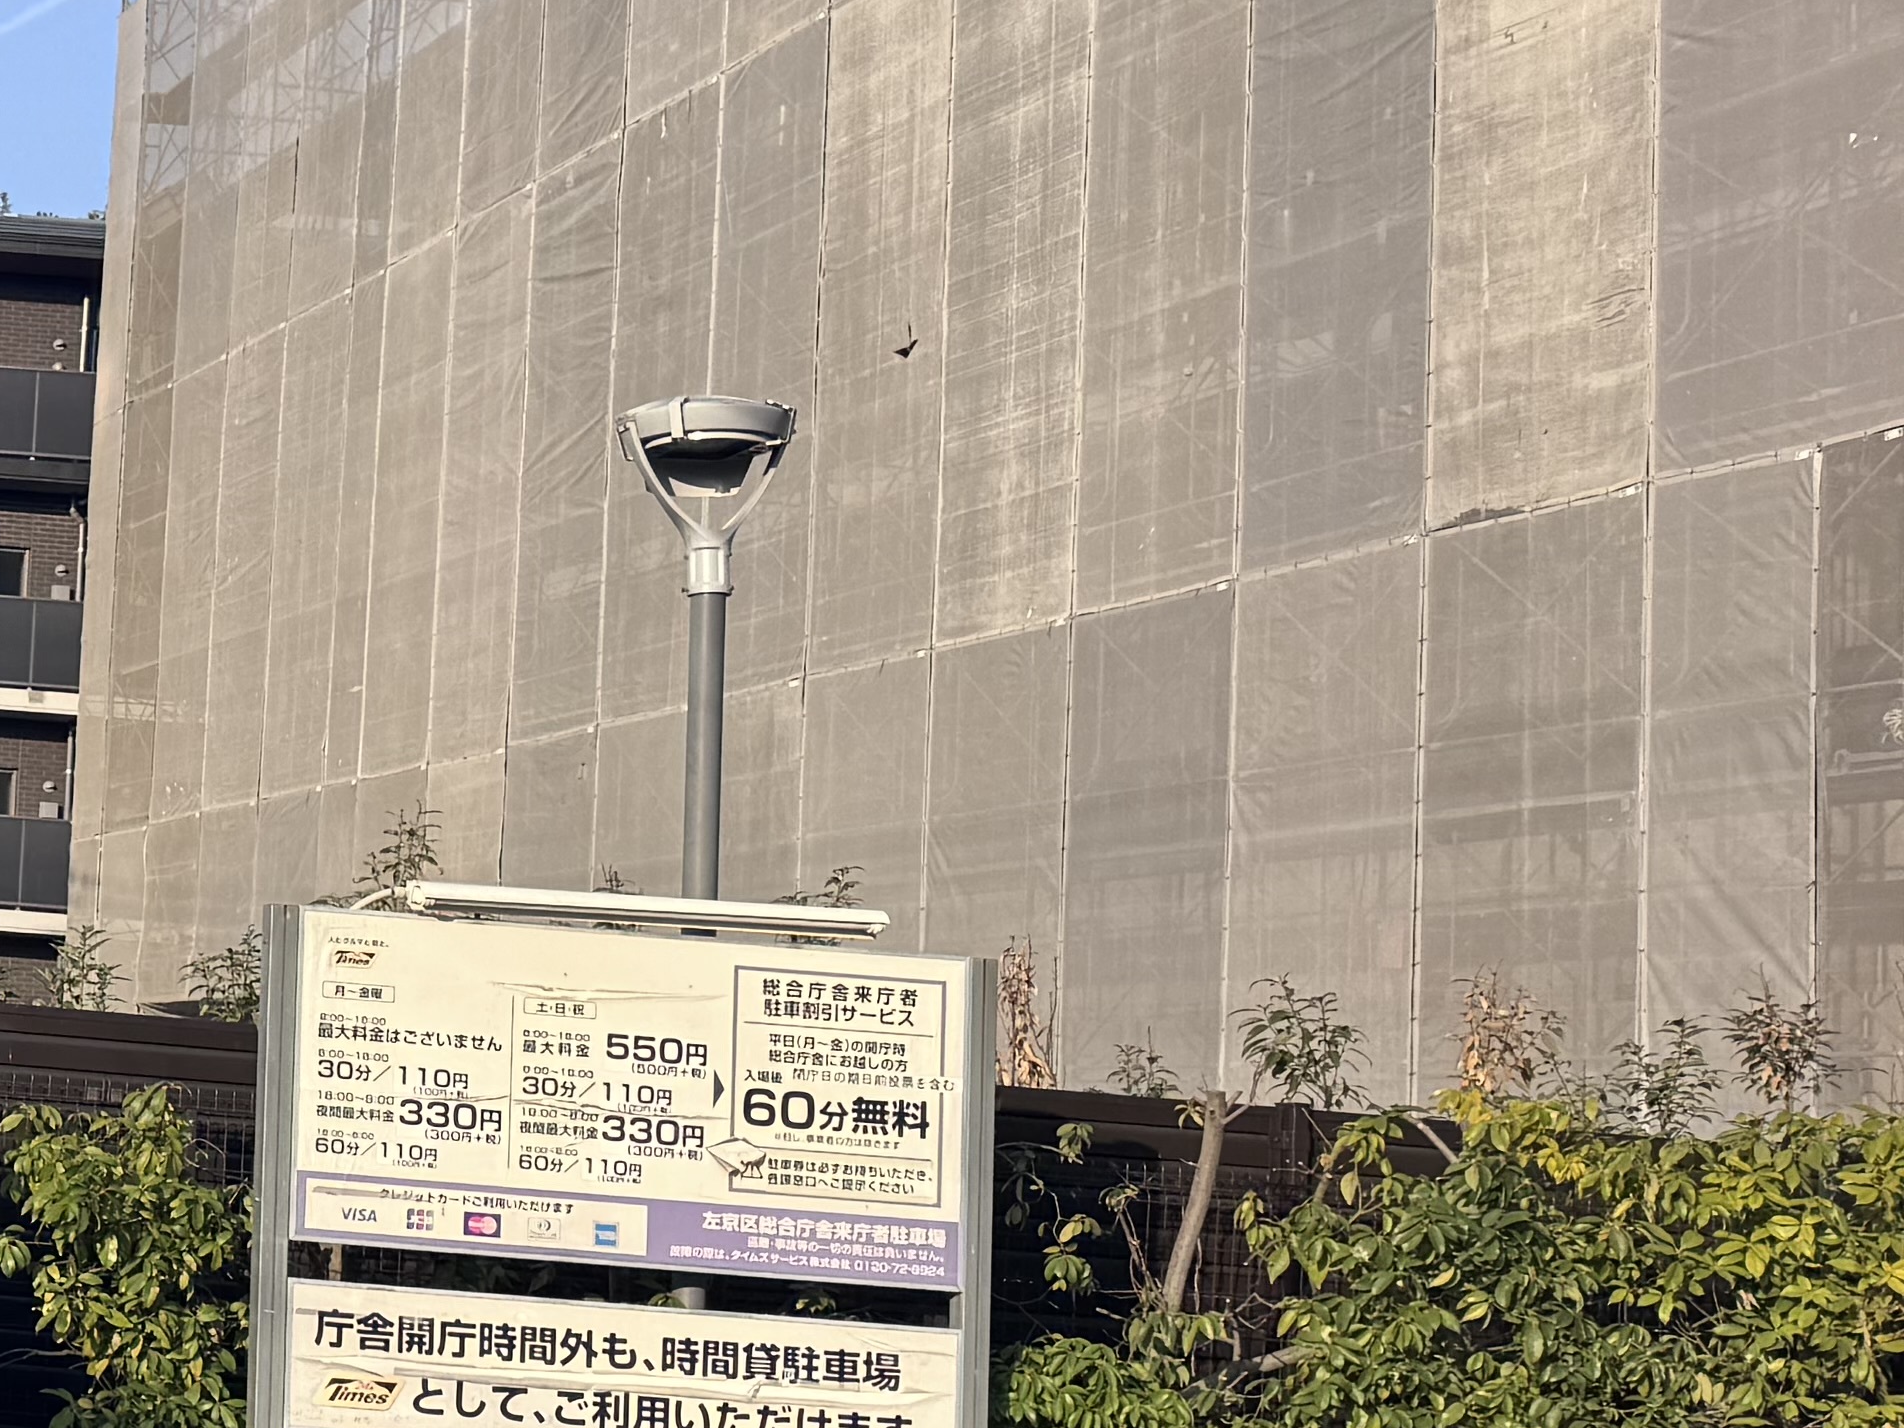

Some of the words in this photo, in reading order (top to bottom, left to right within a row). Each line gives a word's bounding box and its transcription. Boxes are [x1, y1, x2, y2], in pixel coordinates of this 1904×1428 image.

[762, 978, 918, 1007] 総合庁舎来庁者
[763, 998, 915, 1027] 駐車割引サービス
[318, 1022, 502, 1052] 最大料金はございません
[606, 1033, 708, 1066] 550円
[399, 1098, 502, 1132] 330円
[743, 1088, 930, 1139] 60分無料
[602, 1114, 705, 1148] 330円
[341, 1207, 378, 1223] VISA
[702, 1210, 946, 1248] 左京区総合庁舎来庁者駐車場
[314, 1308, 902, 1391] 庁舎開庁時間外も、時間貸駐車場
[329, 1382, 390, 1405] Times
